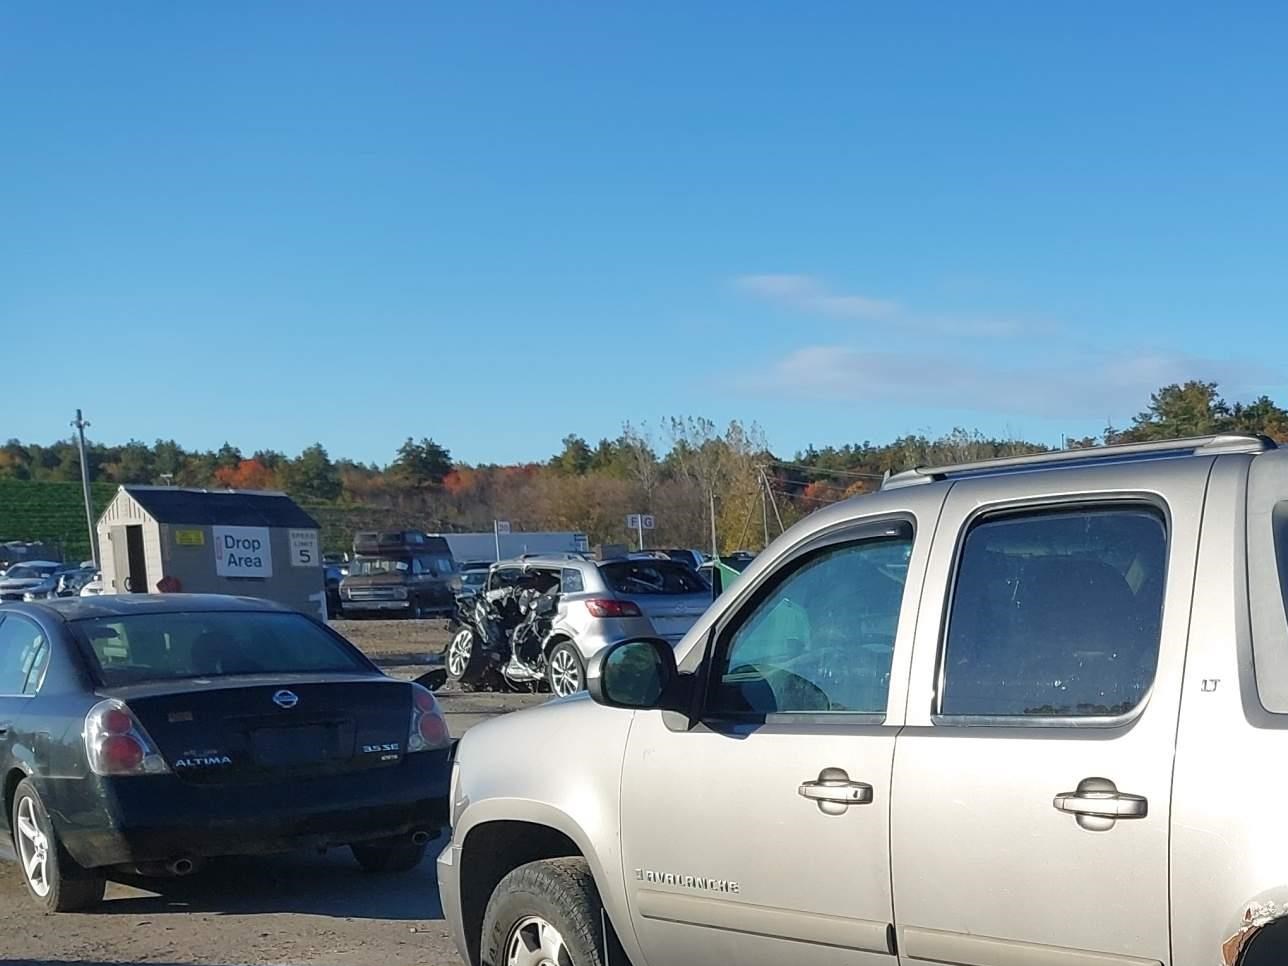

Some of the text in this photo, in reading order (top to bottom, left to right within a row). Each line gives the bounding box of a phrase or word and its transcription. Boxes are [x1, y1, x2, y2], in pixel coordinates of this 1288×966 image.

[224, 535, 261, 552] Drop
[227, 553, 263, 568] Area
[299, 549, 311, 563] 5
[1200, 678, 1221, 692] LT
[175, 756, 232, 767] ALTIMA
[645, 869, 740, 894] AVALANCHE
